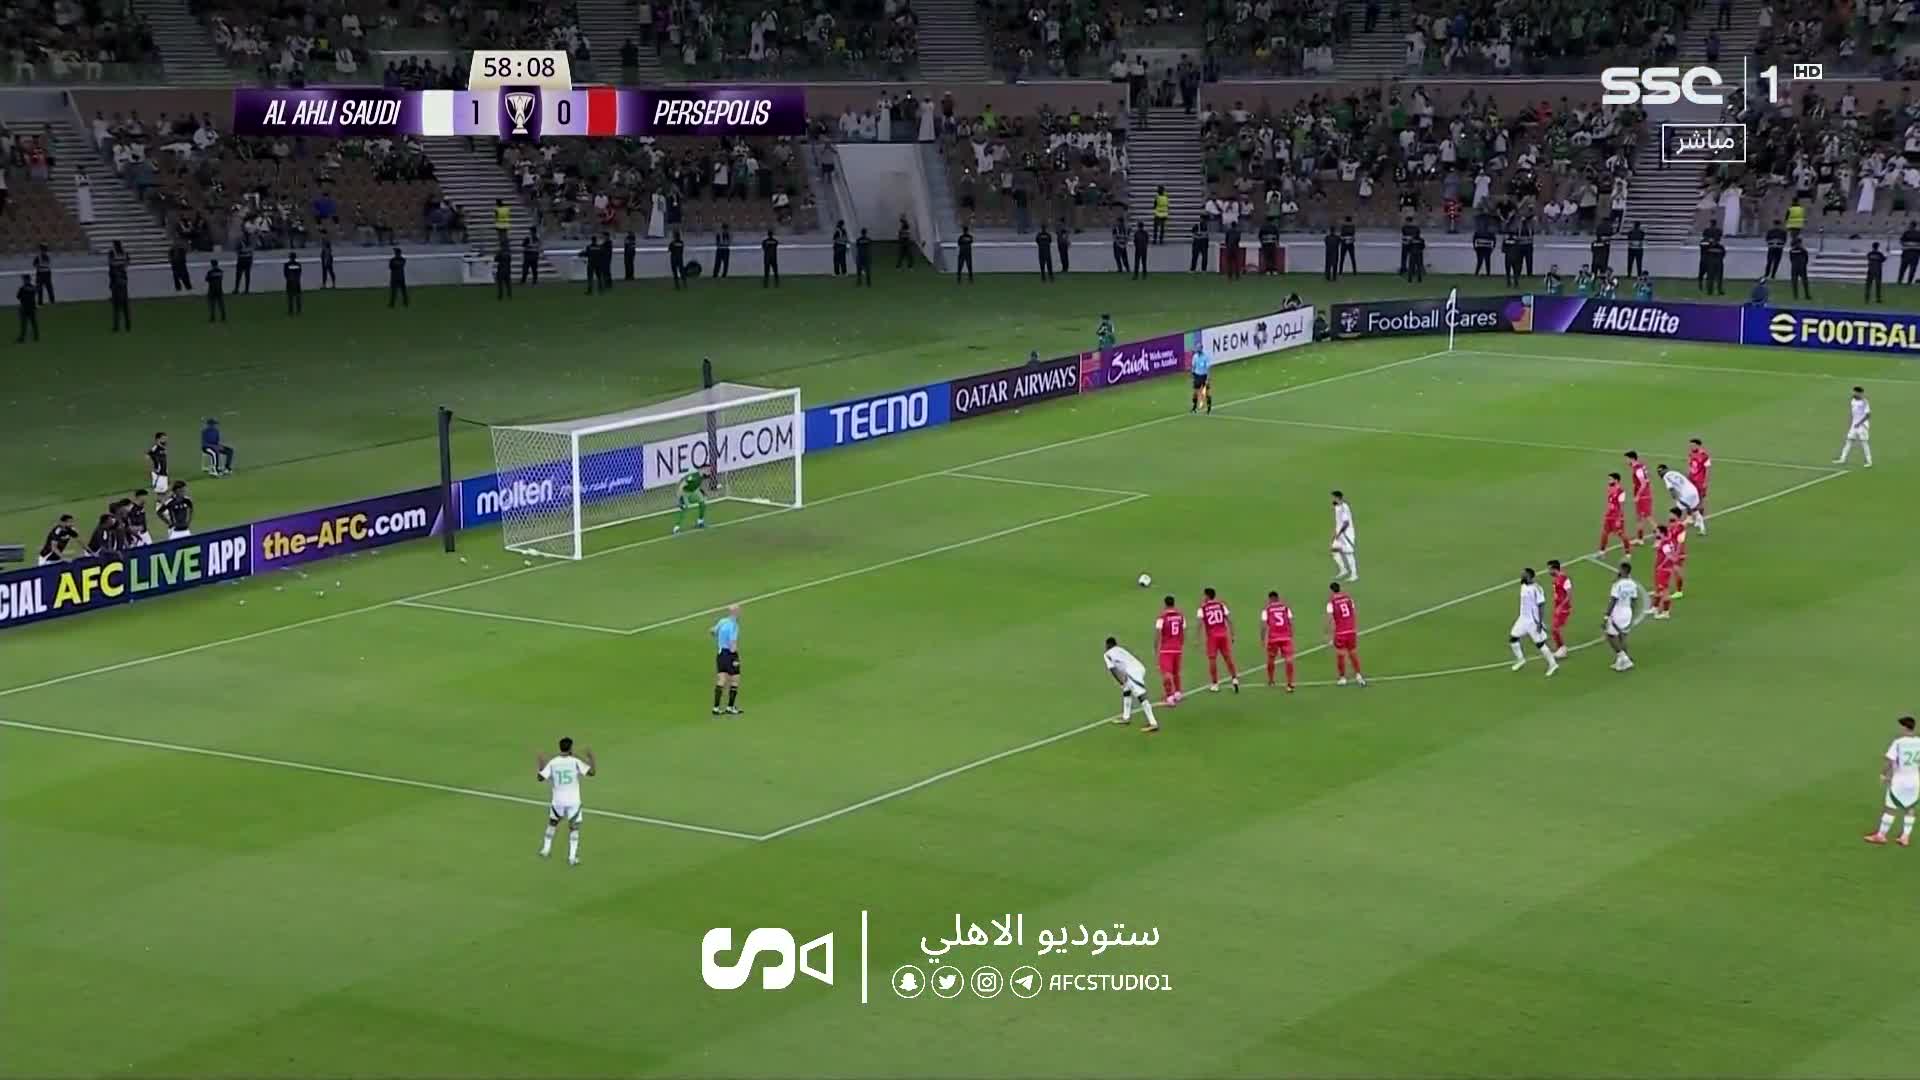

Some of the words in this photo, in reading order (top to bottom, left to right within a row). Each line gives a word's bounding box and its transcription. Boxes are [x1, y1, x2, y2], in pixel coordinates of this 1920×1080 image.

[1368, 309, 1439, 331] Football
[1446, 308, 1497, 328] Cares
[1592, 306, 1680, 335] #ACLElite
[1212, 331, 1249, 353] NEOM
[956, 381, 1008, 413] QATAR
[1013, 365, 1076, 399] AIRWAYS
[829, 391, 928, 444] TECNO
[477, 480, 553, 515] molten
[262, 506, 427, 560] the-AFC.com
[53, 561, 124, 609] AFC
[130, 545, 201, 593] LIVE
[207, 536, 247, 577] APP
[1171, 621, 1179, 635] 6
[1206, 610, 1224, 625] 20
[1274, 611, 1284, 626] 5
[555, 769, 573, 785] 15
